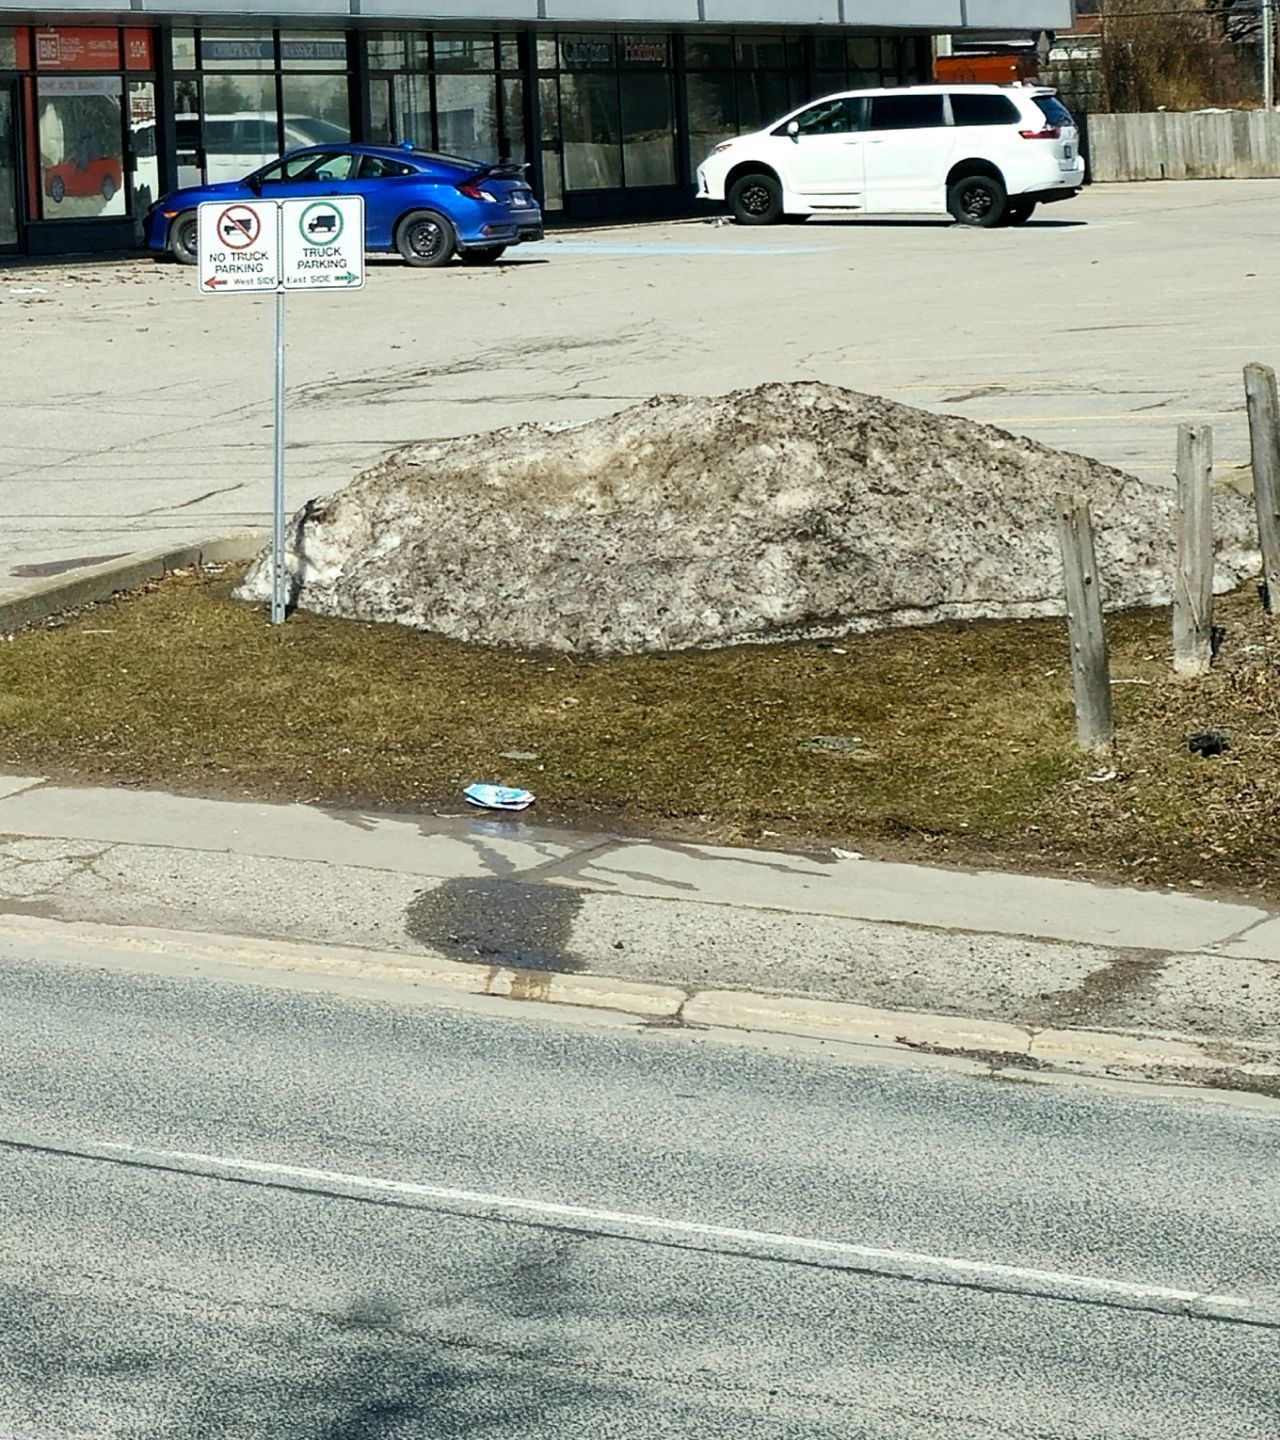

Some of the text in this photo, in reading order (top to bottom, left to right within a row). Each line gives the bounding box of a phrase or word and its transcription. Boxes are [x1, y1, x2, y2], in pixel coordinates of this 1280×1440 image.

[209, 251, 269, 262] NO TRUCK
[302, 247, 342, 258] TRUCK
[215, 264, 263, 274] PARKING
[297, 259, 347, 270] PARKING
[233, 276, 276, 286] West SIDE
[287, 275, 331, 284] East SIDE
